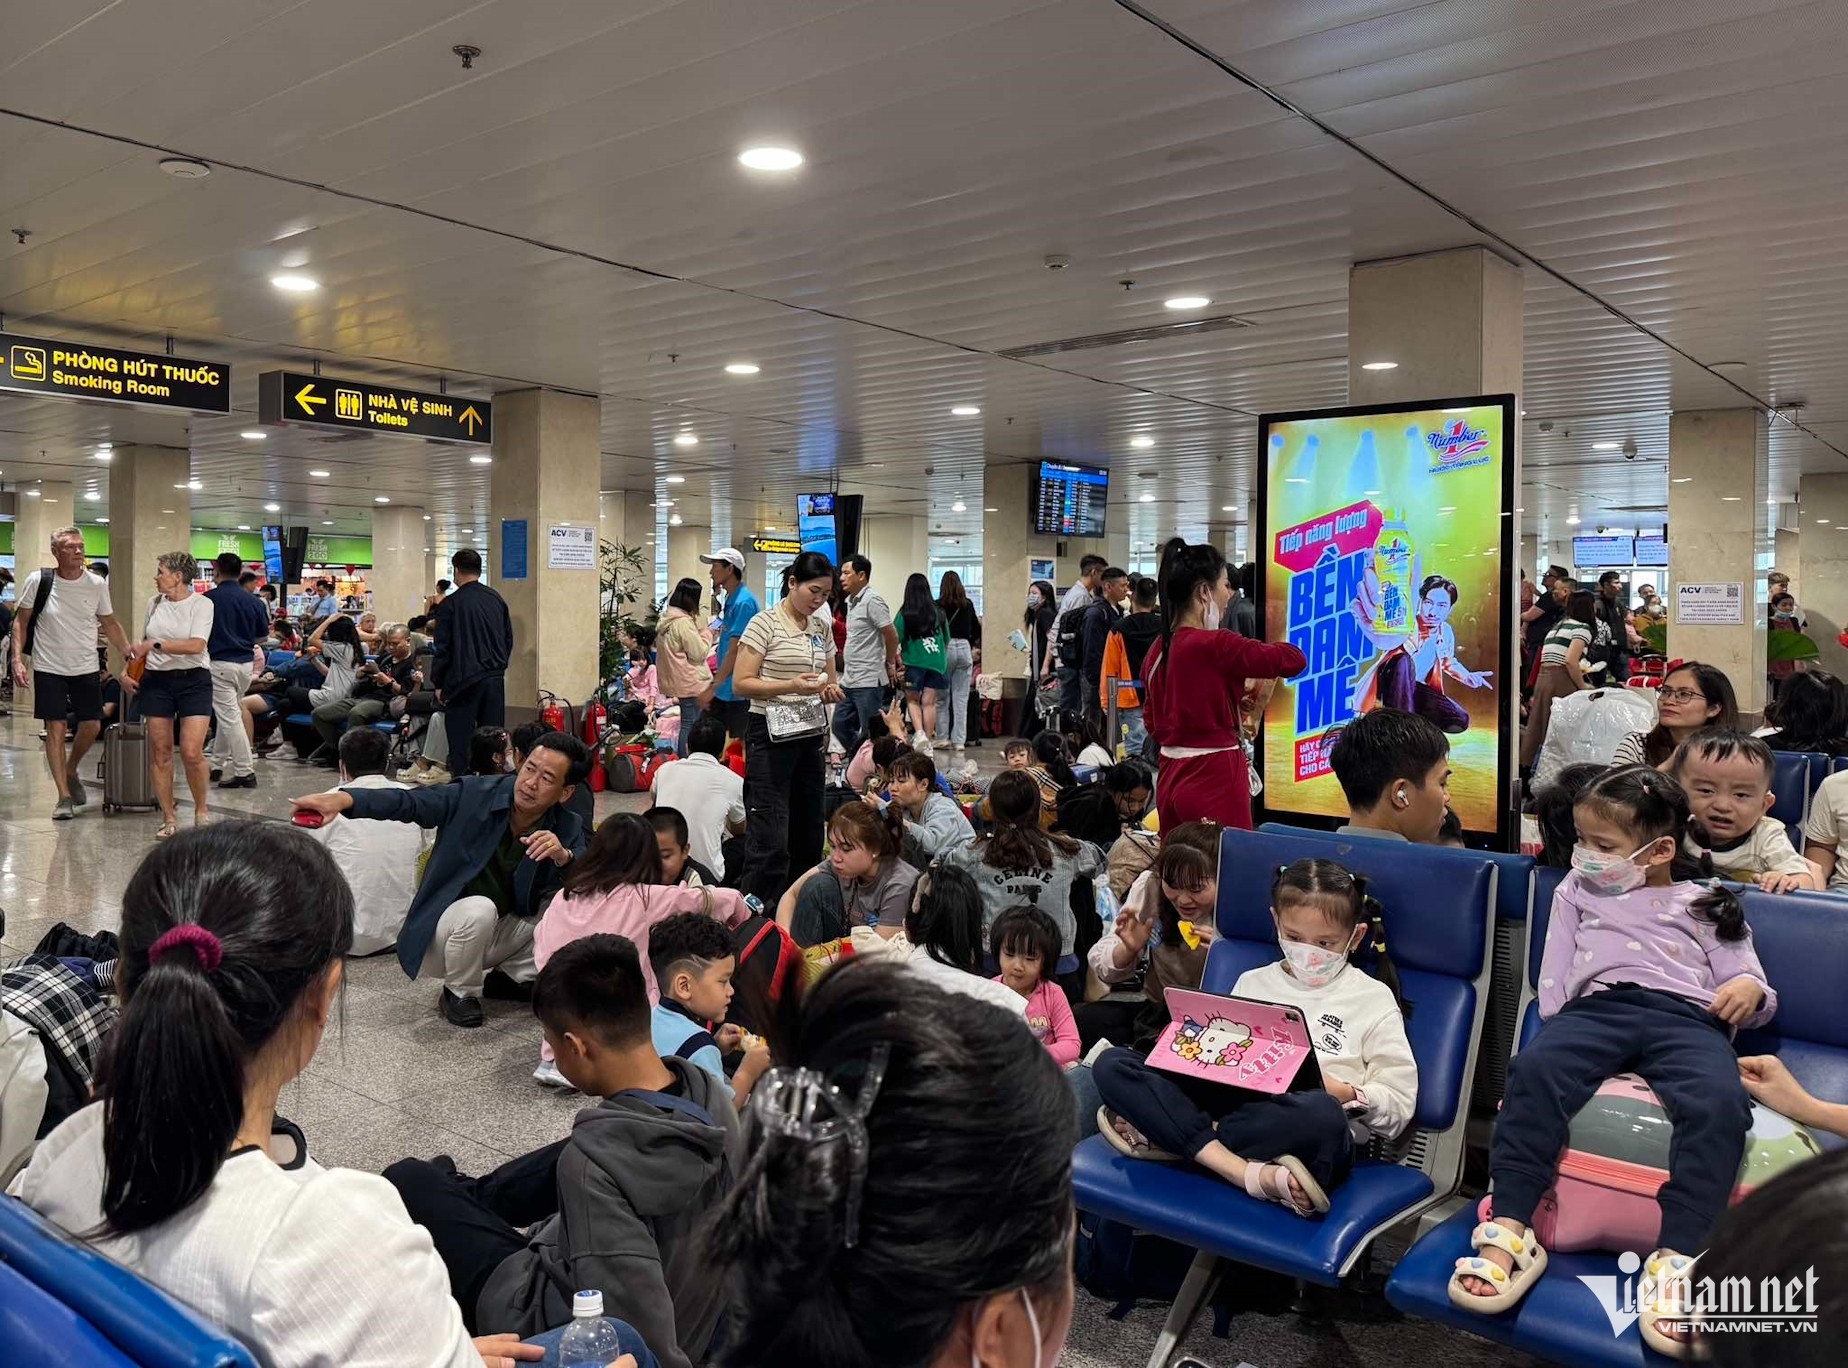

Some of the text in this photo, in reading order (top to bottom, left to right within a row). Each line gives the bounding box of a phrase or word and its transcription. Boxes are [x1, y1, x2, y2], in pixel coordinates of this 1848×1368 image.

[53, 350, 220, 386] PHÒNG HÚT THUỐC
[52, 371, 170, 397] Smoking Room
[368, 393, 453, 417] NHÀ VỆ SINH
[367, 410, 408, 427] Toilets
[1427, 426, 1480, 450] Number
[551, 529, 567, 538] ACV
[1280, 509, 1367, 554] Tiếp năng lượng
[1680, 586, 1702, 594] ACV
[1296, 657, 1357, 733] MÊ
[993, 867, 1053, 885] CELINE
